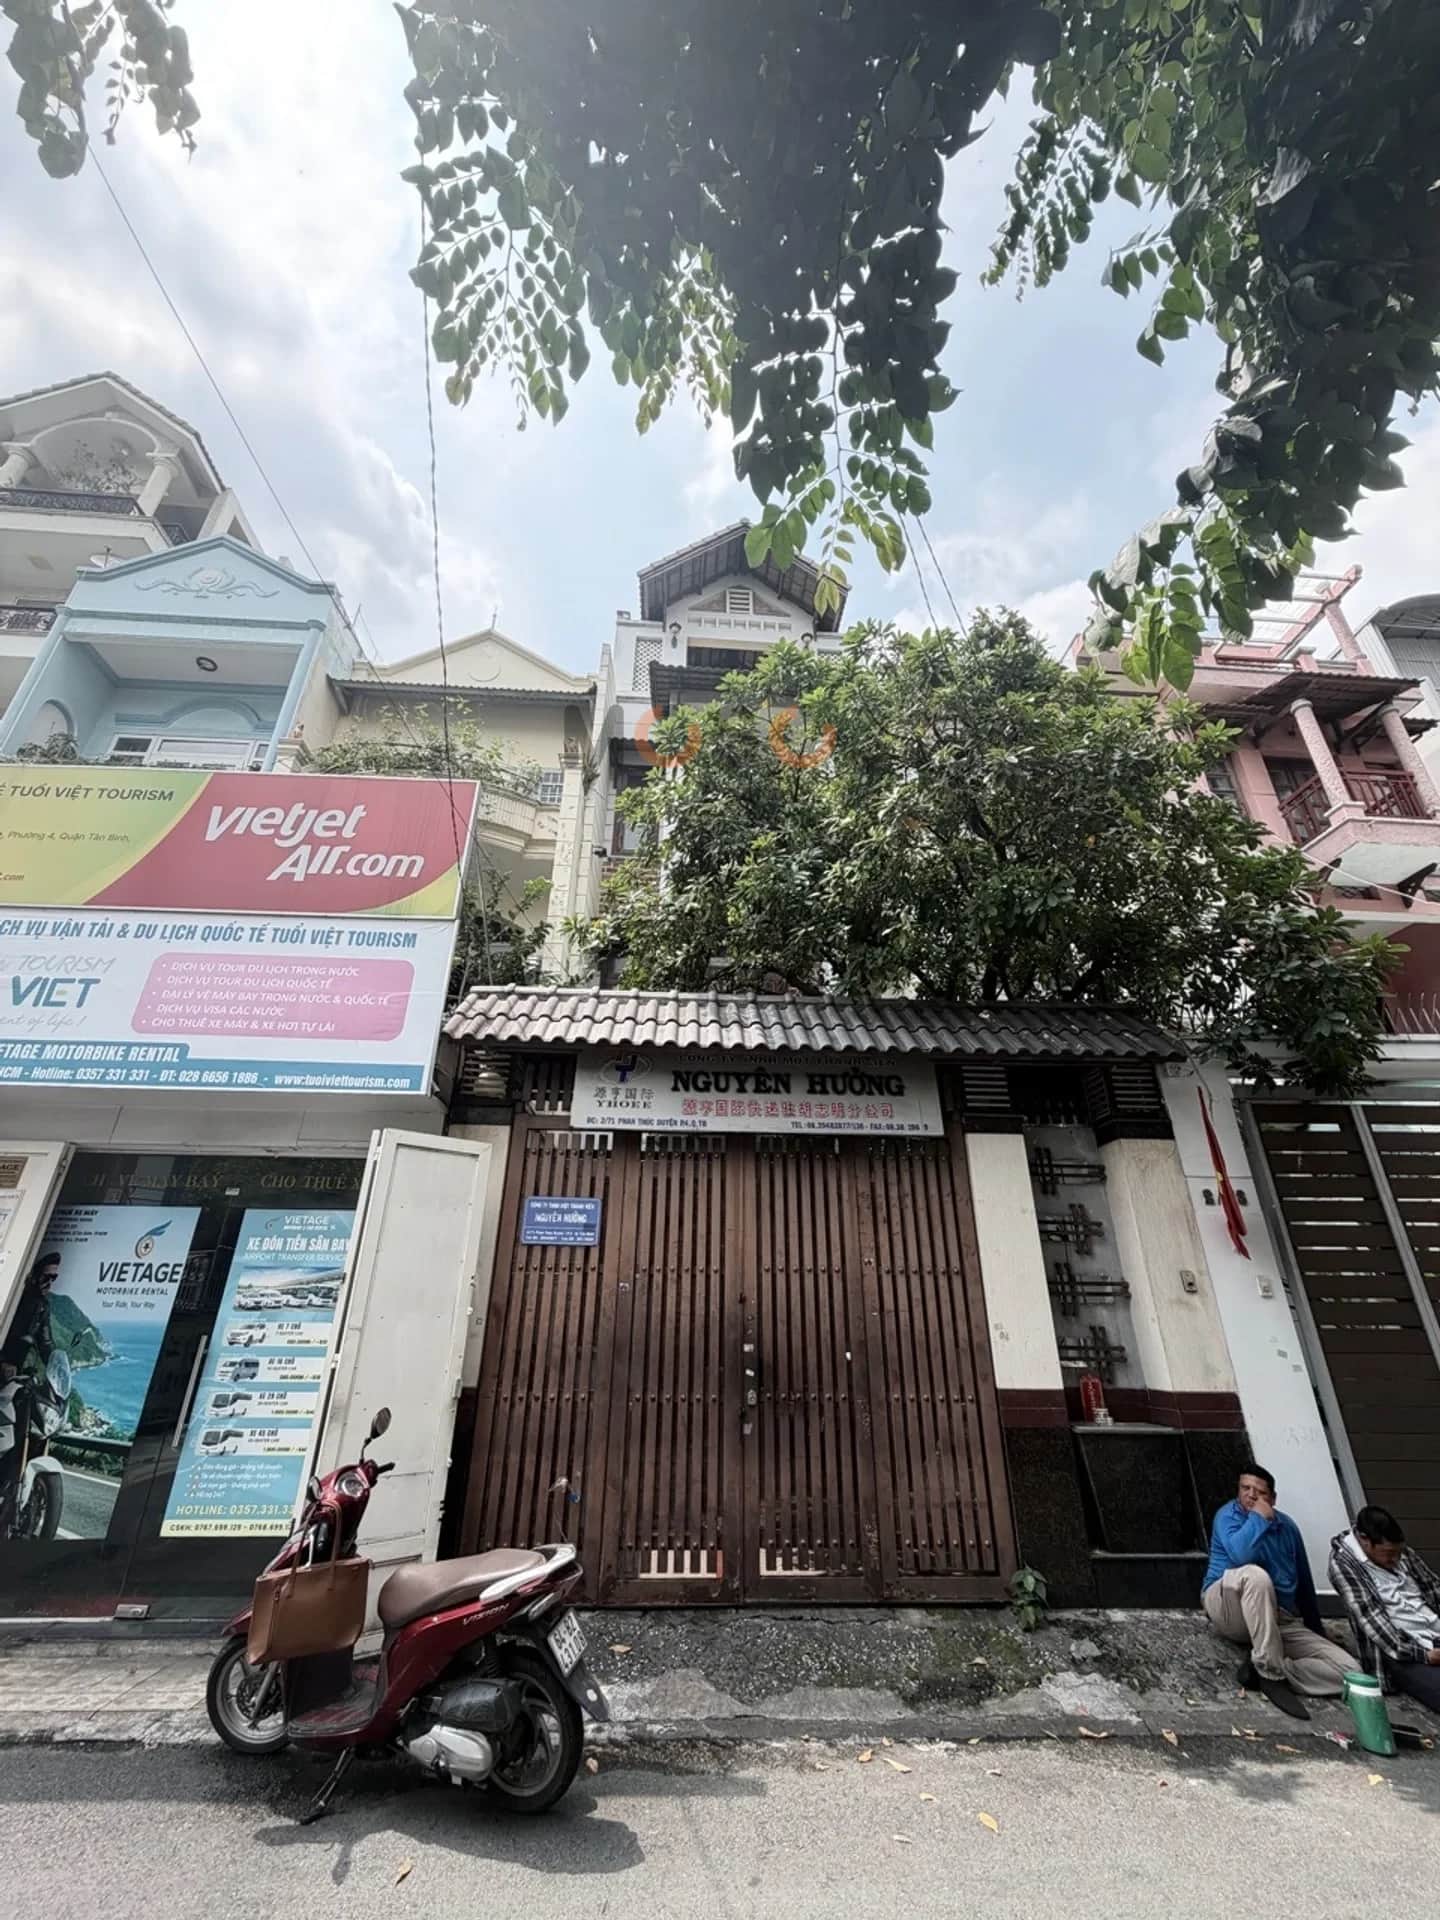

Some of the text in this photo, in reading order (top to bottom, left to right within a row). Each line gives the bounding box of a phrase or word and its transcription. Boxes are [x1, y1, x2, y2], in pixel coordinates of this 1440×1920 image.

[55, 784, 93, 800] VIỆT
[98, 787, 175, 801] TOURISM
[26, 920, 48, 939] VỤ
[51, 918, 84, 939] VẬN
[88, 917, 114, 938] TẢI
[117, 923, 129, 938] &
[133, 923, 158, 939] DU
[160, 924, 197, 943] LỊCH
[201, 921, 244, 943] QUỐC
[249, 922, 270, 943] TẾ
[310, 927, 344, 948] VIỆT
[347, 930, 418, 948] TOURISM
[218, 962, 245, 973] TOUR
[247, 963, 264, 973] DU
[289, 966, 327, 976] TRONG
[213, 977, 241, 986] TOUR
[244, 978, 260, 986] DU
[12, 975, 101, 1008] VIET
[239, 992, 259, 1001] BAY
[260, 992, 297, 1003] TRONG
[332, 995, 341, 1004] &
[156, 1004, 183, 1014] DỊCH
[203, 1005, 227, 1014] VISA
[151, 1018, 175, 1027] CHO
[208, 1020, 224, 1028] XE
[250, 1020, 259, 1029] &
[262, 1021, 277, 1030] XE
[41, 1044, 126, 1061] MOTORBIKE
[128, 1046, 182, 1062] RENTAL
[31, 1066, 74, 1080] Hotline:
[76, 1068, 104, 1080] 0357
[105, 1068, 127, 1080] 331
[130, 1069, 150, 1081] 331
[179, 1070, 199, 1082] 028
[671, 1066, 791, 1094] NGUYÊN
[260, 1172, 346, 1190] CHO THUÊ
[284, 1215, 329, 1225] VIETAGE
[246, 1237, 261, 1250] XE
[98, 1261, 183, 1284] VIETAGE
[96, 1287, 168, 1296] MOTORBIKE RENTAL
[176, 1504, 227, 1515] HOTLINE:
